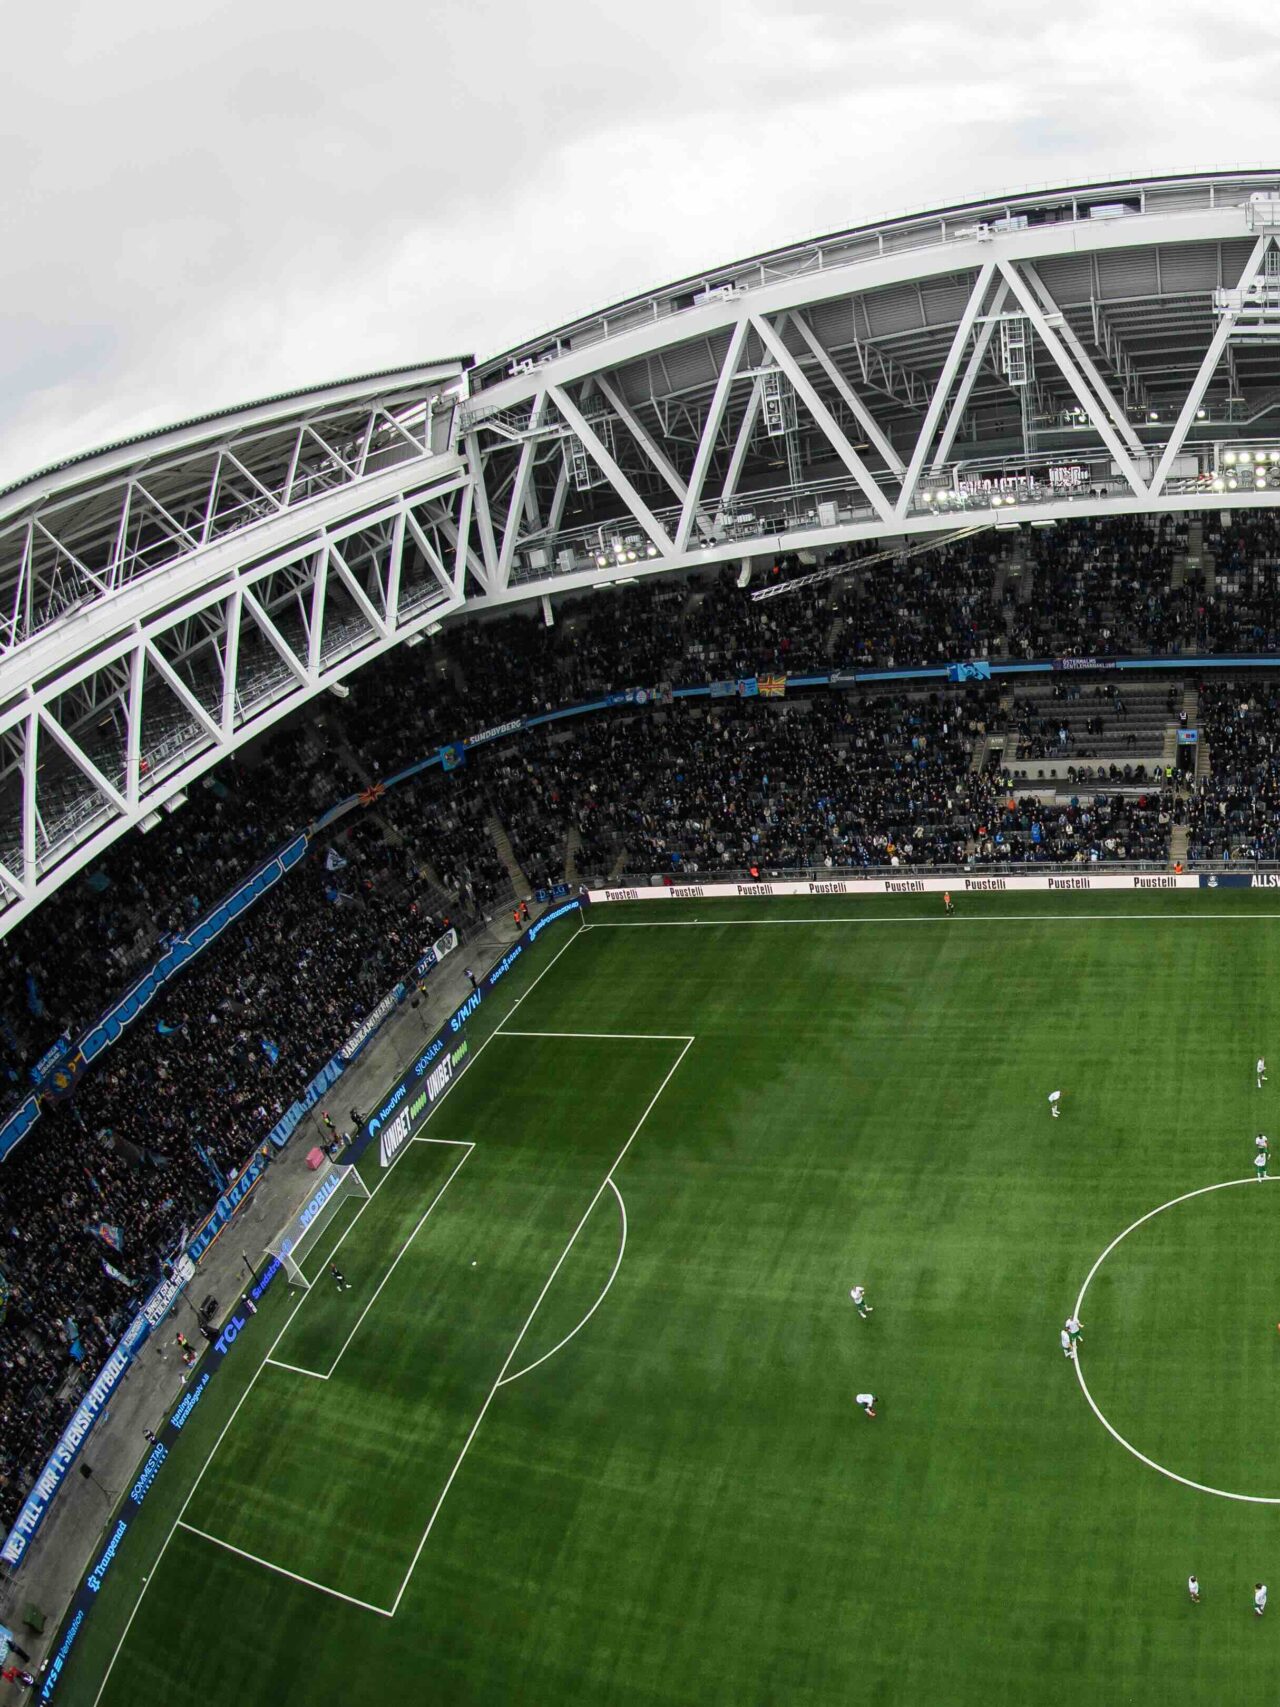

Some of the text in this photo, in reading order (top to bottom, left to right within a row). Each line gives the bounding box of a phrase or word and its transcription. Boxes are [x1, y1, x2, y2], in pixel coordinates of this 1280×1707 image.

[469, 719, 522, 745] SUNDBYBERG
[606, 888, 638, 900] Puustelli
[669, 885, 703, 897] Puustelli
[737, 882, 773, 895] Puustelli
[809, 881, 847, 893] Puustelli
[885, 879, 925, 892] Puustelli
[965, 878, 1006, 890] Puustelli
[1048, 877, 1090, 889] Puustelli
[1134, 876, 1177, 888] Puustelli
[414, 1039, 444, 1076] SJÖNÄRA
[426, 1053, 453, 1102] UNIBET
[379, 1085, 407, 1121] NordVPN
[383, 1105, 411, 1159] UNIBET
[301, 1173, 340, 1229] MOBILL
[214, 1315, 246, 1355] TCL
[170, 1392, 192, 1427] Haninge
[5, 1535, 27, 1564] NEJ
[18, 1501, 44, 1535] TILL
[38, 1466, 62, 1502] VAR
[62, 1411, 96, 1463] SVENSK
[88, 1350, 130, 1412] FOTBOLL
[130, 1442, 164, 1500] SOMMESTAD
[58, 1609, 84, 1659] Ventilation
[41, 1668, 58, 1698] VTS
